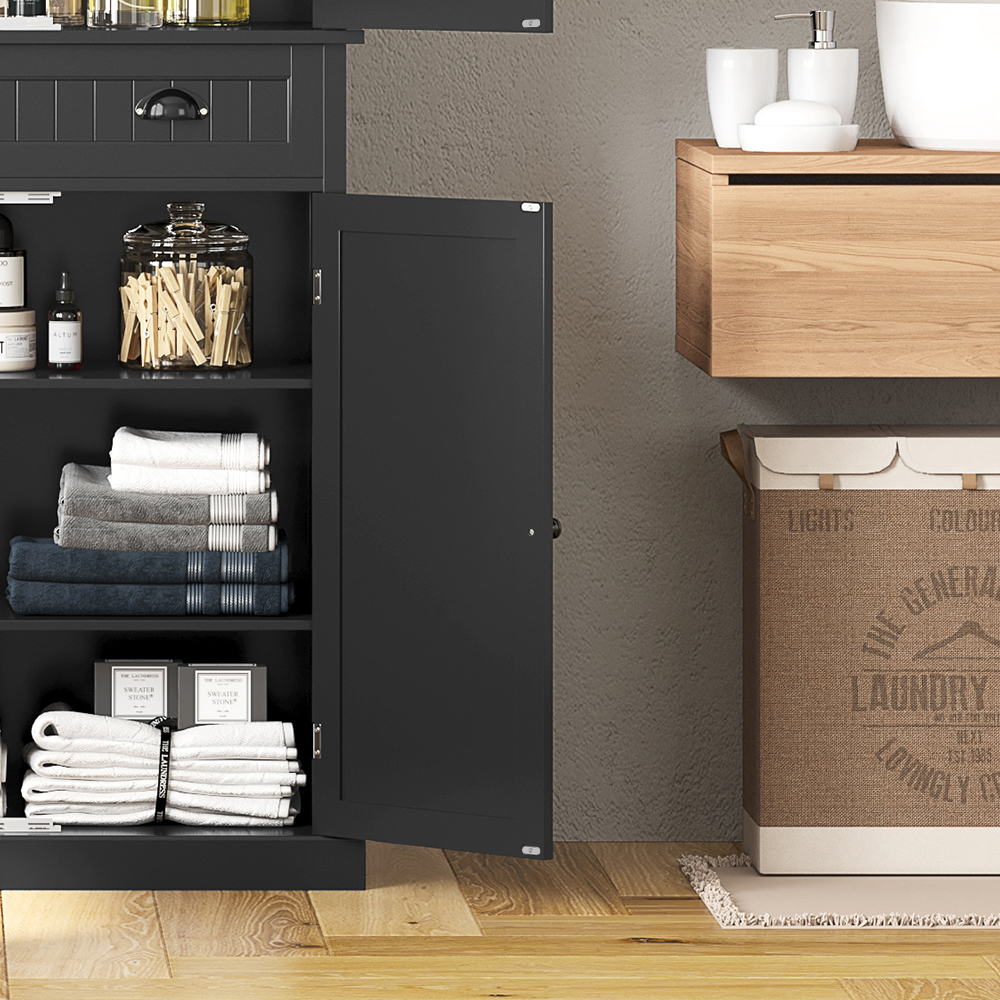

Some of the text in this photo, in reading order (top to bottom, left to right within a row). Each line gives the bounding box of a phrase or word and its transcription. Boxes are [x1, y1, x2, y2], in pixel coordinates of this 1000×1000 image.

[788, 508, 855, 532] LIGHTS
[861, 610, 907, 660] THE
[851, 673, 988, 712] LAUNDRY
[876, 737, 970, 805] LOVINGLY
